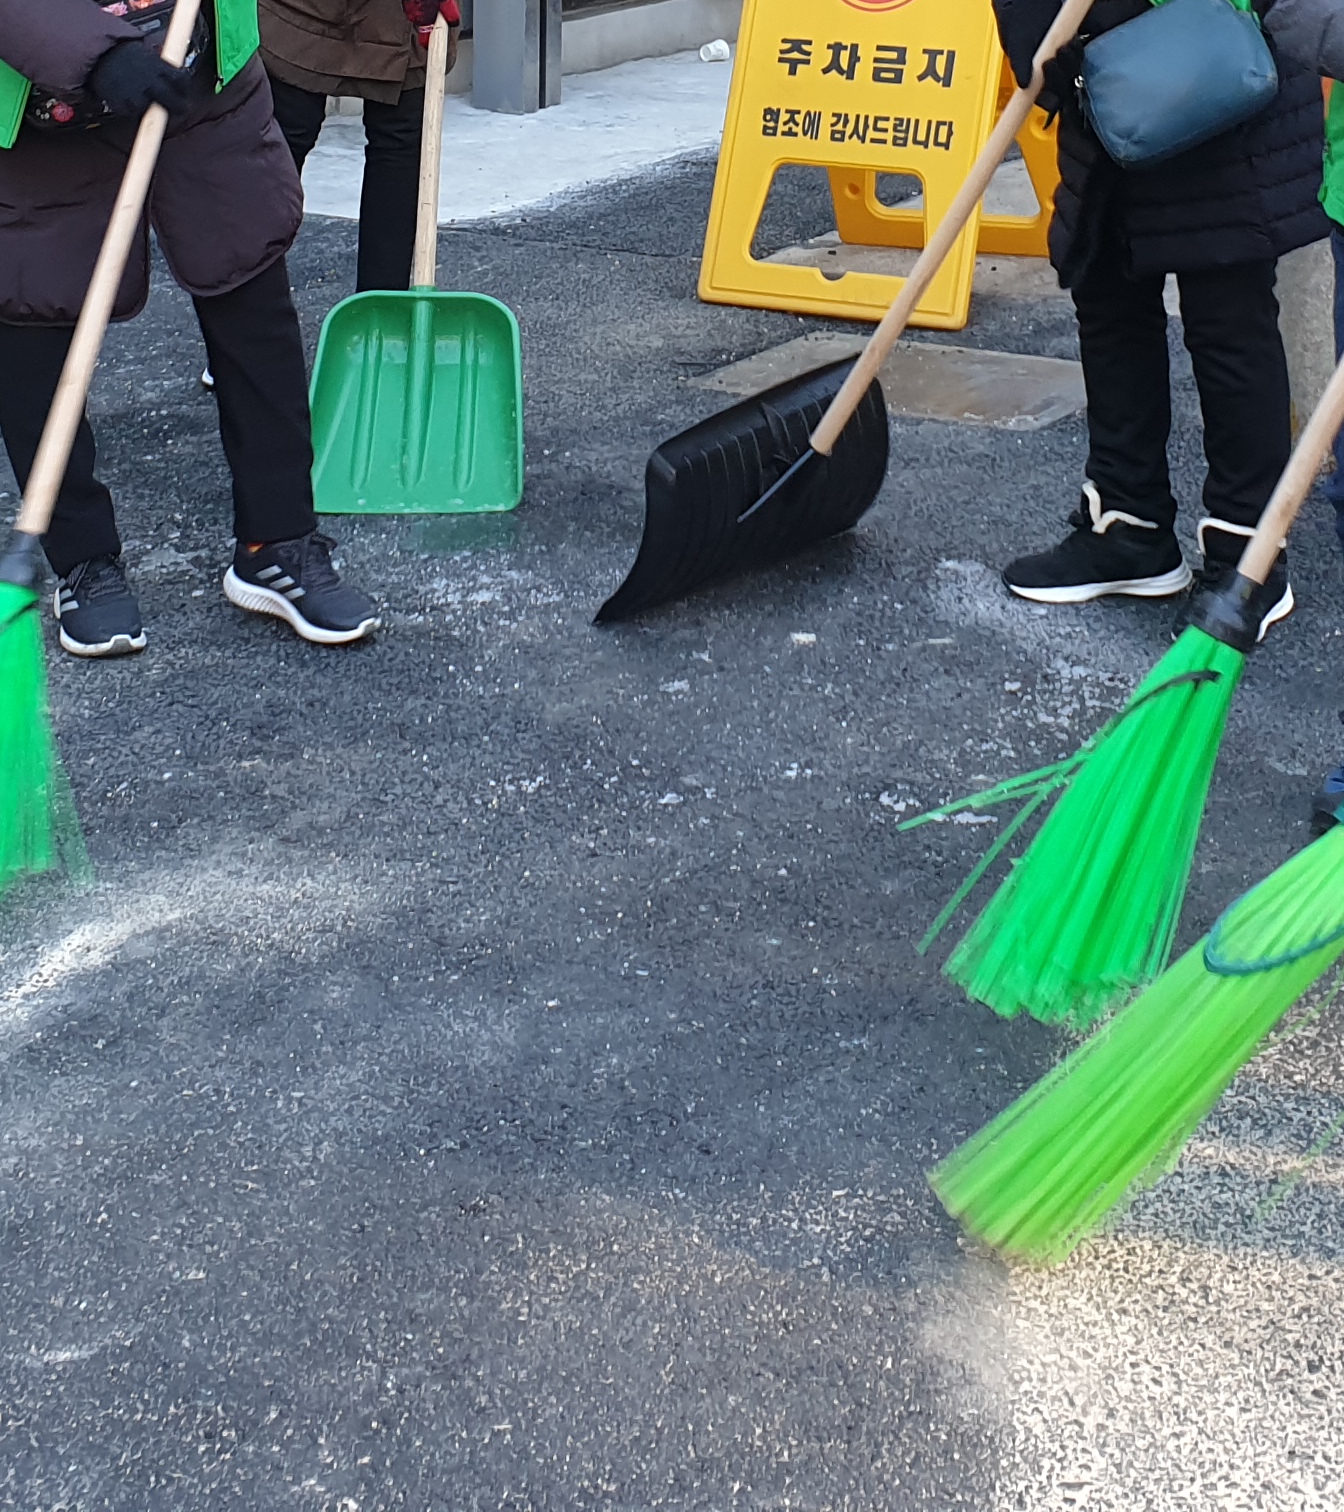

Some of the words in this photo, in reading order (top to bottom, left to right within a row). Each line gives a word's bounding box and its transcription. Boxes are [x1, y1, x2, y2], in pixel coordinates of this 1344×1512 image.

[777, 38, 956, 88] 주차금지
[761, 107, 822, 141] 협조에
[829, 111, 954, 151] 감사드립니다
